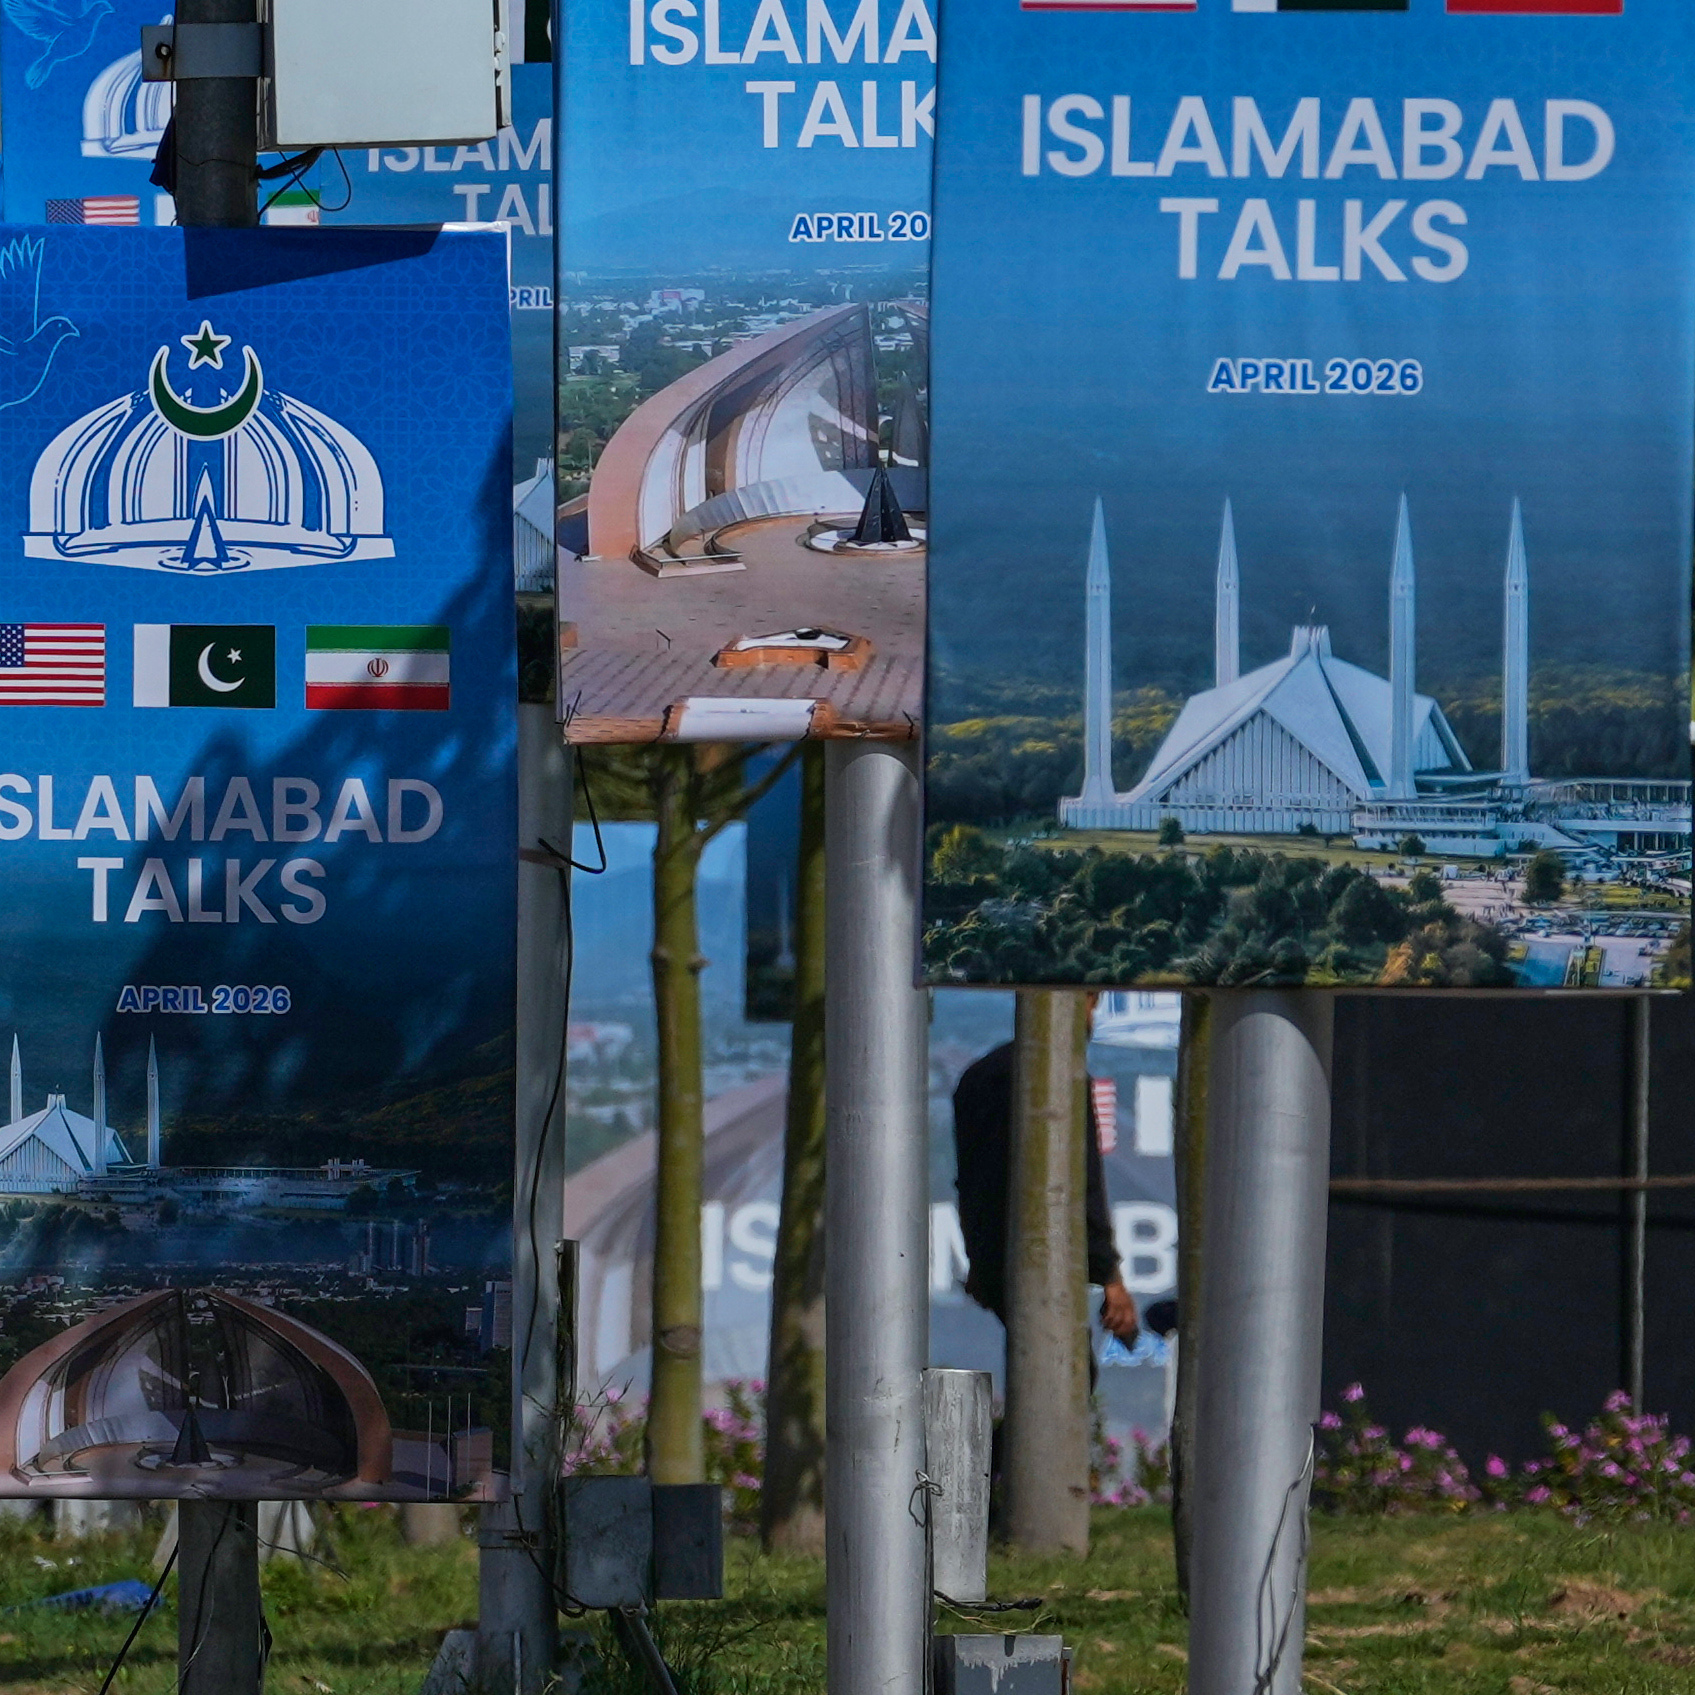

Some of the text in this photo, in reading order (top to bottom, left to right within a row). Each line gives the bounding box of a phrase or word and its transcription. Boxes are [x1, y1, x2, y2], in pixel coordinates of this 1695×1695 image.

[745, 80, 936, 149] TALK
[1021, 94, 1616, 182] ISLAMABAD
[789, 212, 884, 242] APRIL
[1160, 198, 1469, 283] TALKS
[1208, 358, 1423, 395] APRIL 2026
[77, 857, 327, 924] TALKS
[117, 985, 291, 1014] APRIL 2026
